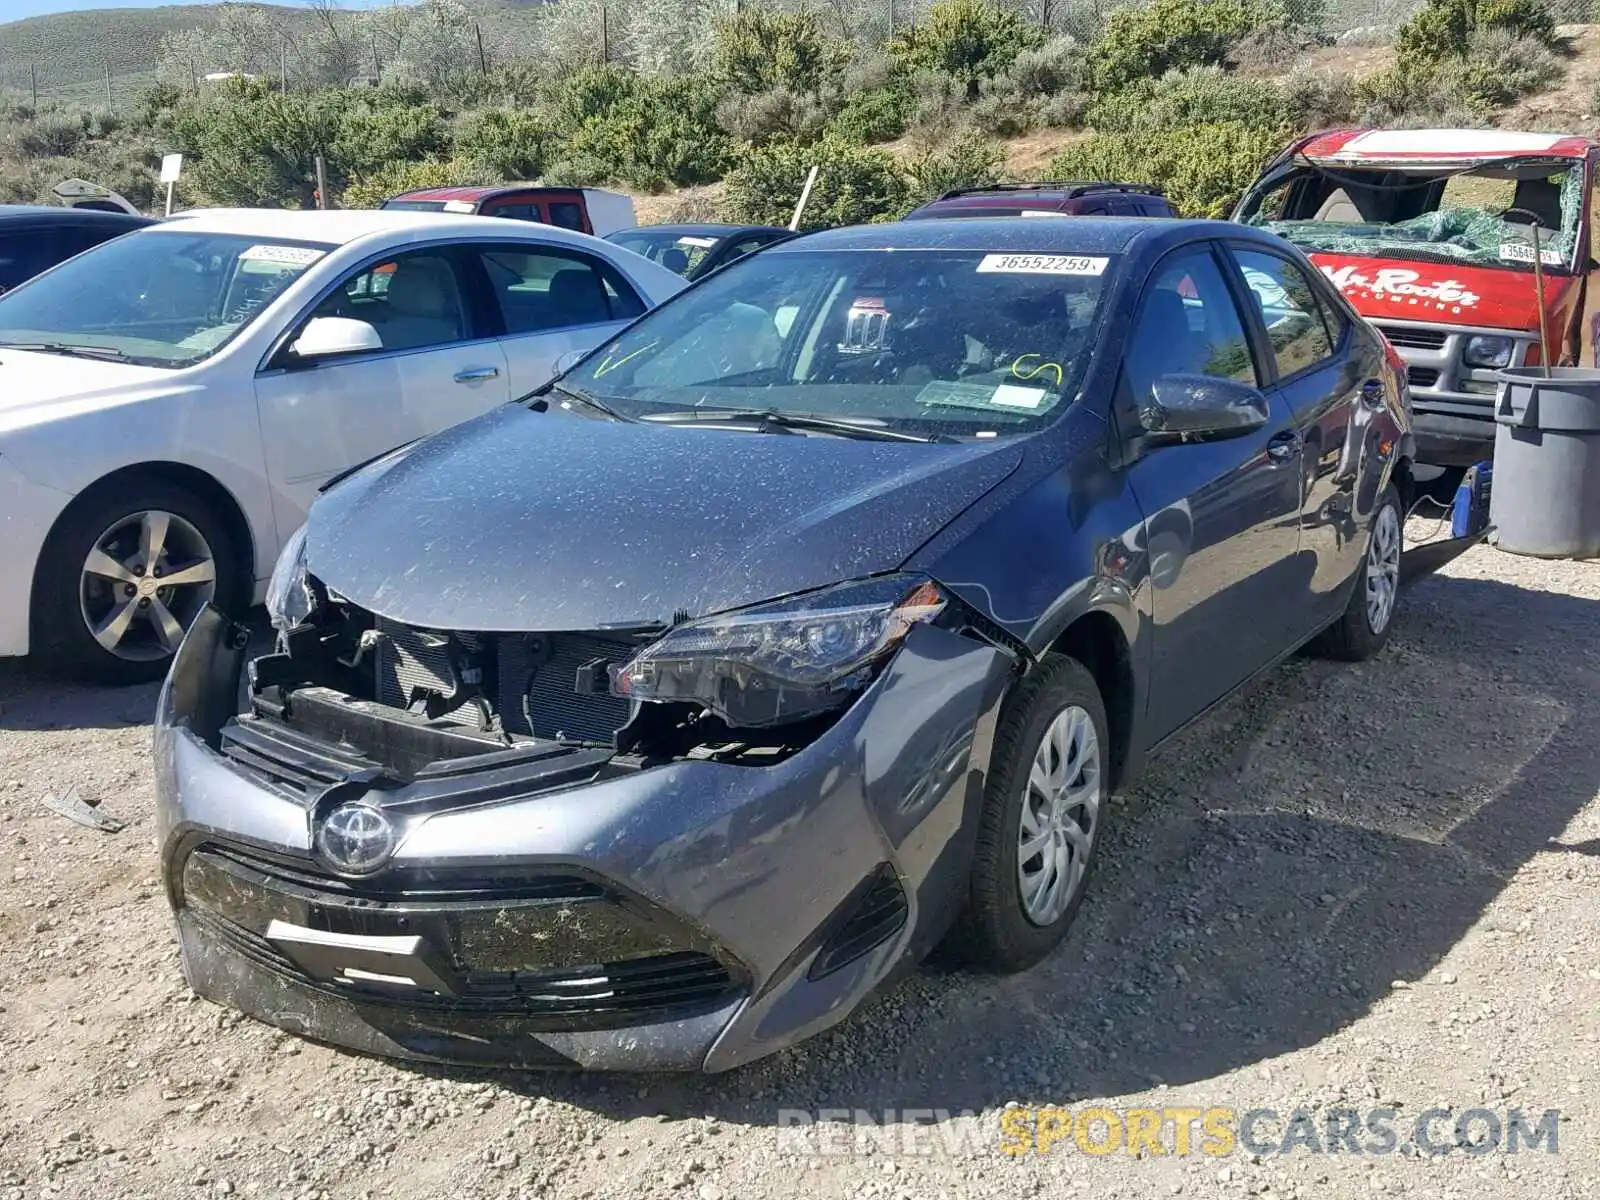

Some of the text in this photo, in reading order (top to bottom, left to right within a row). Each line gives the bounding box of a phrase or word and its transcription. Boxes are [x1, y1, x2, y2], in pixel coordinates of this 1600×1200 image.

[995, 256, 1091, 271] 36552259
[1371, 268, 1481, 306] Rooter
[1347, 290, 1461, 314] PLUMBING
